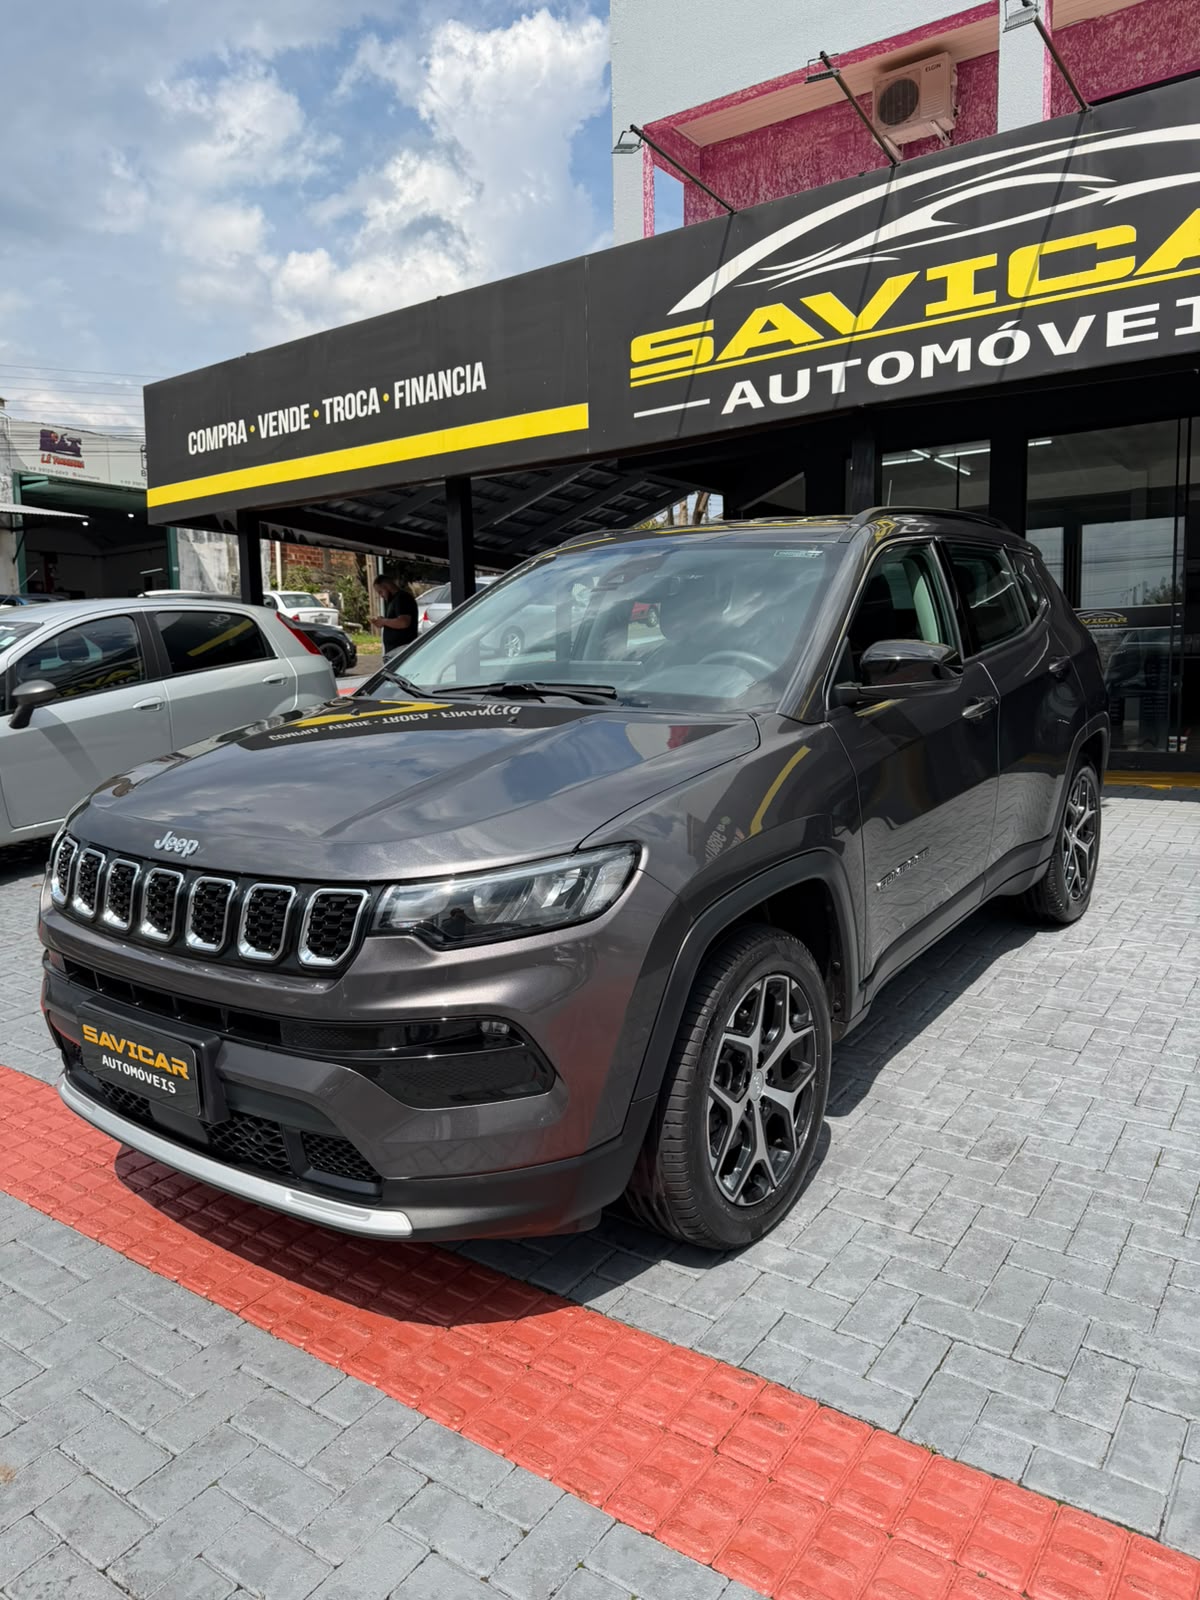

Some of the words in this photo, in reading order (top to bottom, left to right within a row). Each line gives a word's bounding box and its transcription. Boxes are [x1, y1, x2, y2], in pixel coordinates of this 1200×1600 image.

[924, 63, 942, 73] ELGIN
[187, 419, 248, 456] COMPRA
[257, 403, 311, 440] VENDE
[321, 386, 381, 425] TROCA
[393, 361, 488, 410] FINANCIA
[153, 830, 200, 858] Jeep
[82, 1023, 190, 1081] SAVICAR
[101, 1054, 177, 1095] AUTOMÓVEIS
